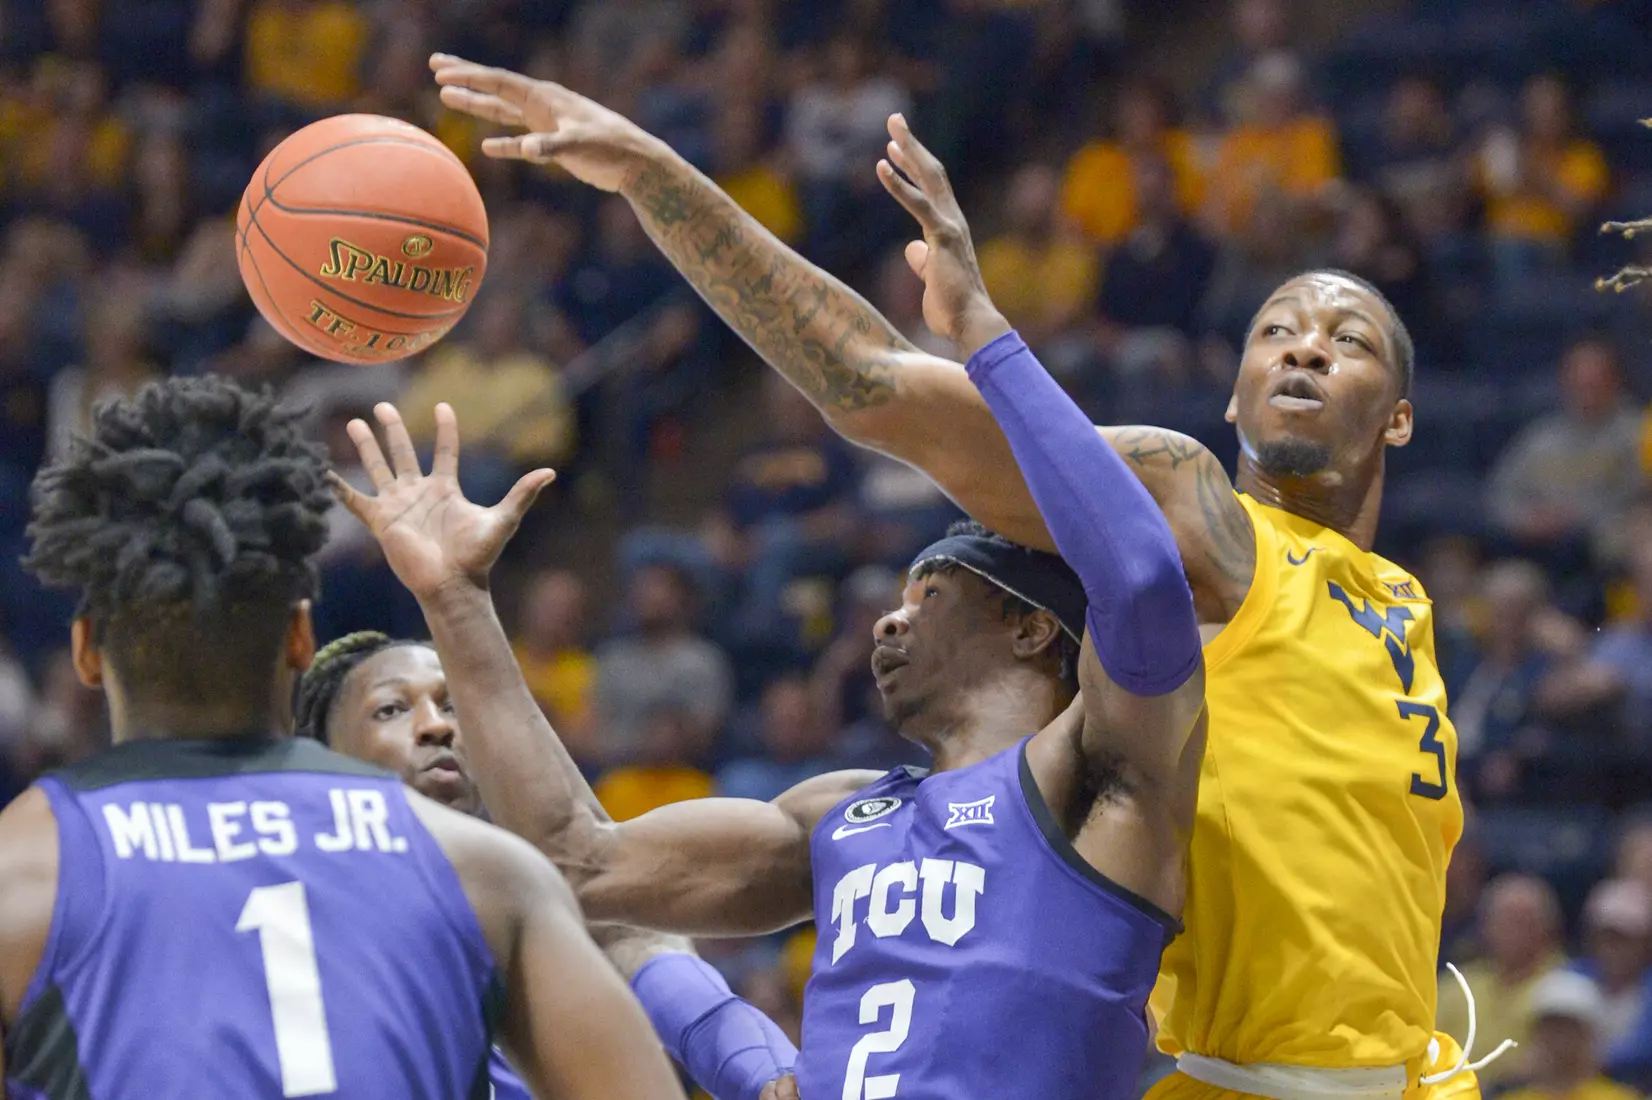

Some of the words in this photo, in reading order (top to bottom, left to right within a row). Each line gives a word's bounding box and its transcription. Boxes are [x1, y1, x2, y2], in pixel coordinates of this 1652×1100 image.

[320, 237, 473, 302] SPALDING
[1395, 700, 1447, 800] 3
[103, 800, 297, 863] MILES
[314, 788, 408, 853] JR.
[950, 801, 990, 824] XII
[831, 857, 986, 966] TCU
[235, 880, 337, 1098] 1
[842, 978, 916, 1100] 2
